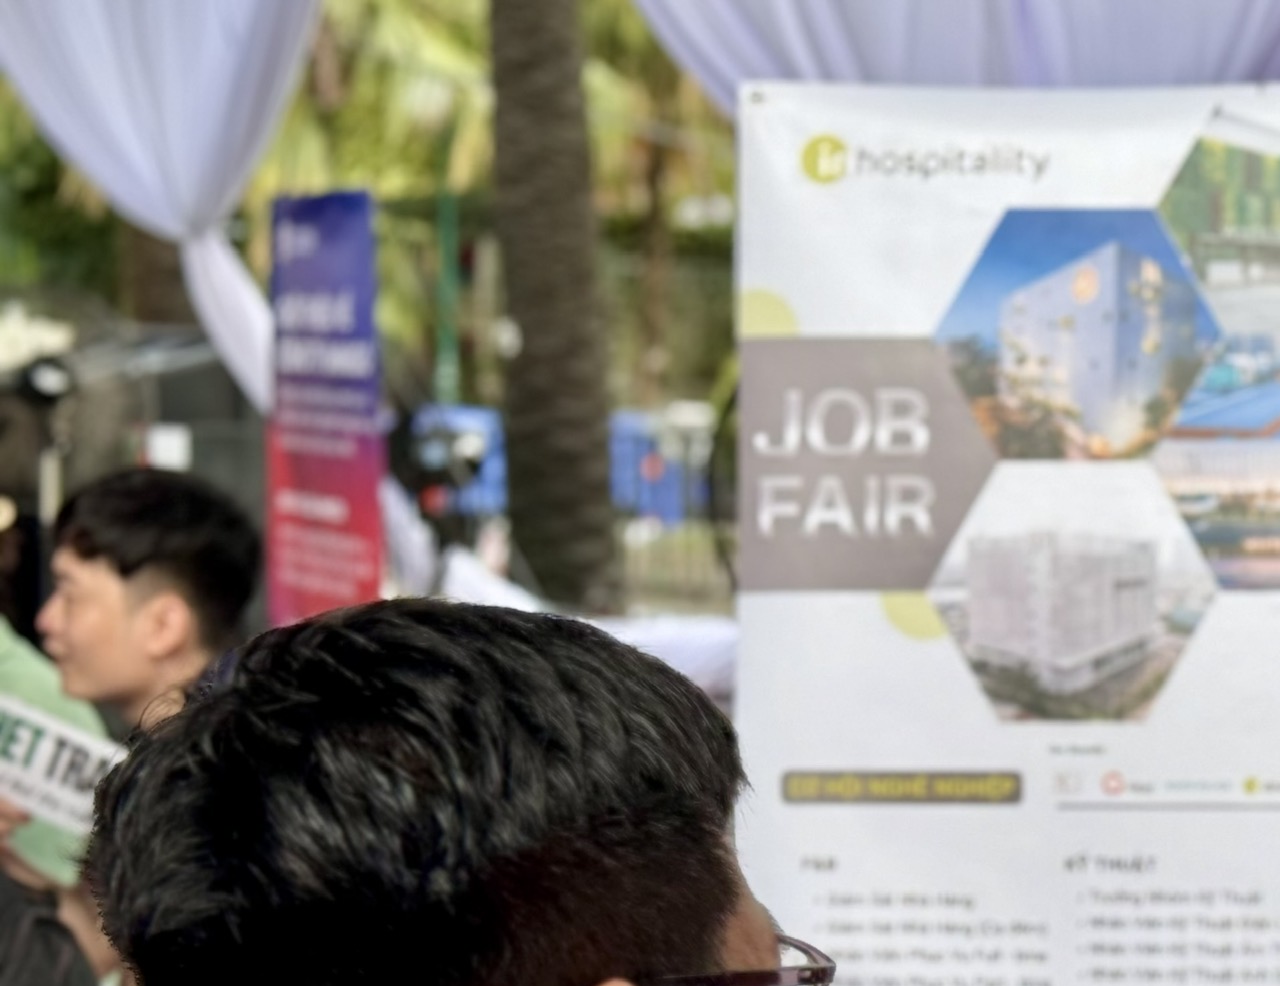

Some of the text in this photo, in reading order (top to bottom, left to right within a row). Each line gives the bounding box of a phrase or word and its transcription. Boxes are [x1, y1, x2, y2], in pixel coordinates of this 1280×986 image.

[855, 144, 1051, 184] hospitality
[753, 387, 930, 456] JOB
[758, 475, 936, 537] FAIR
